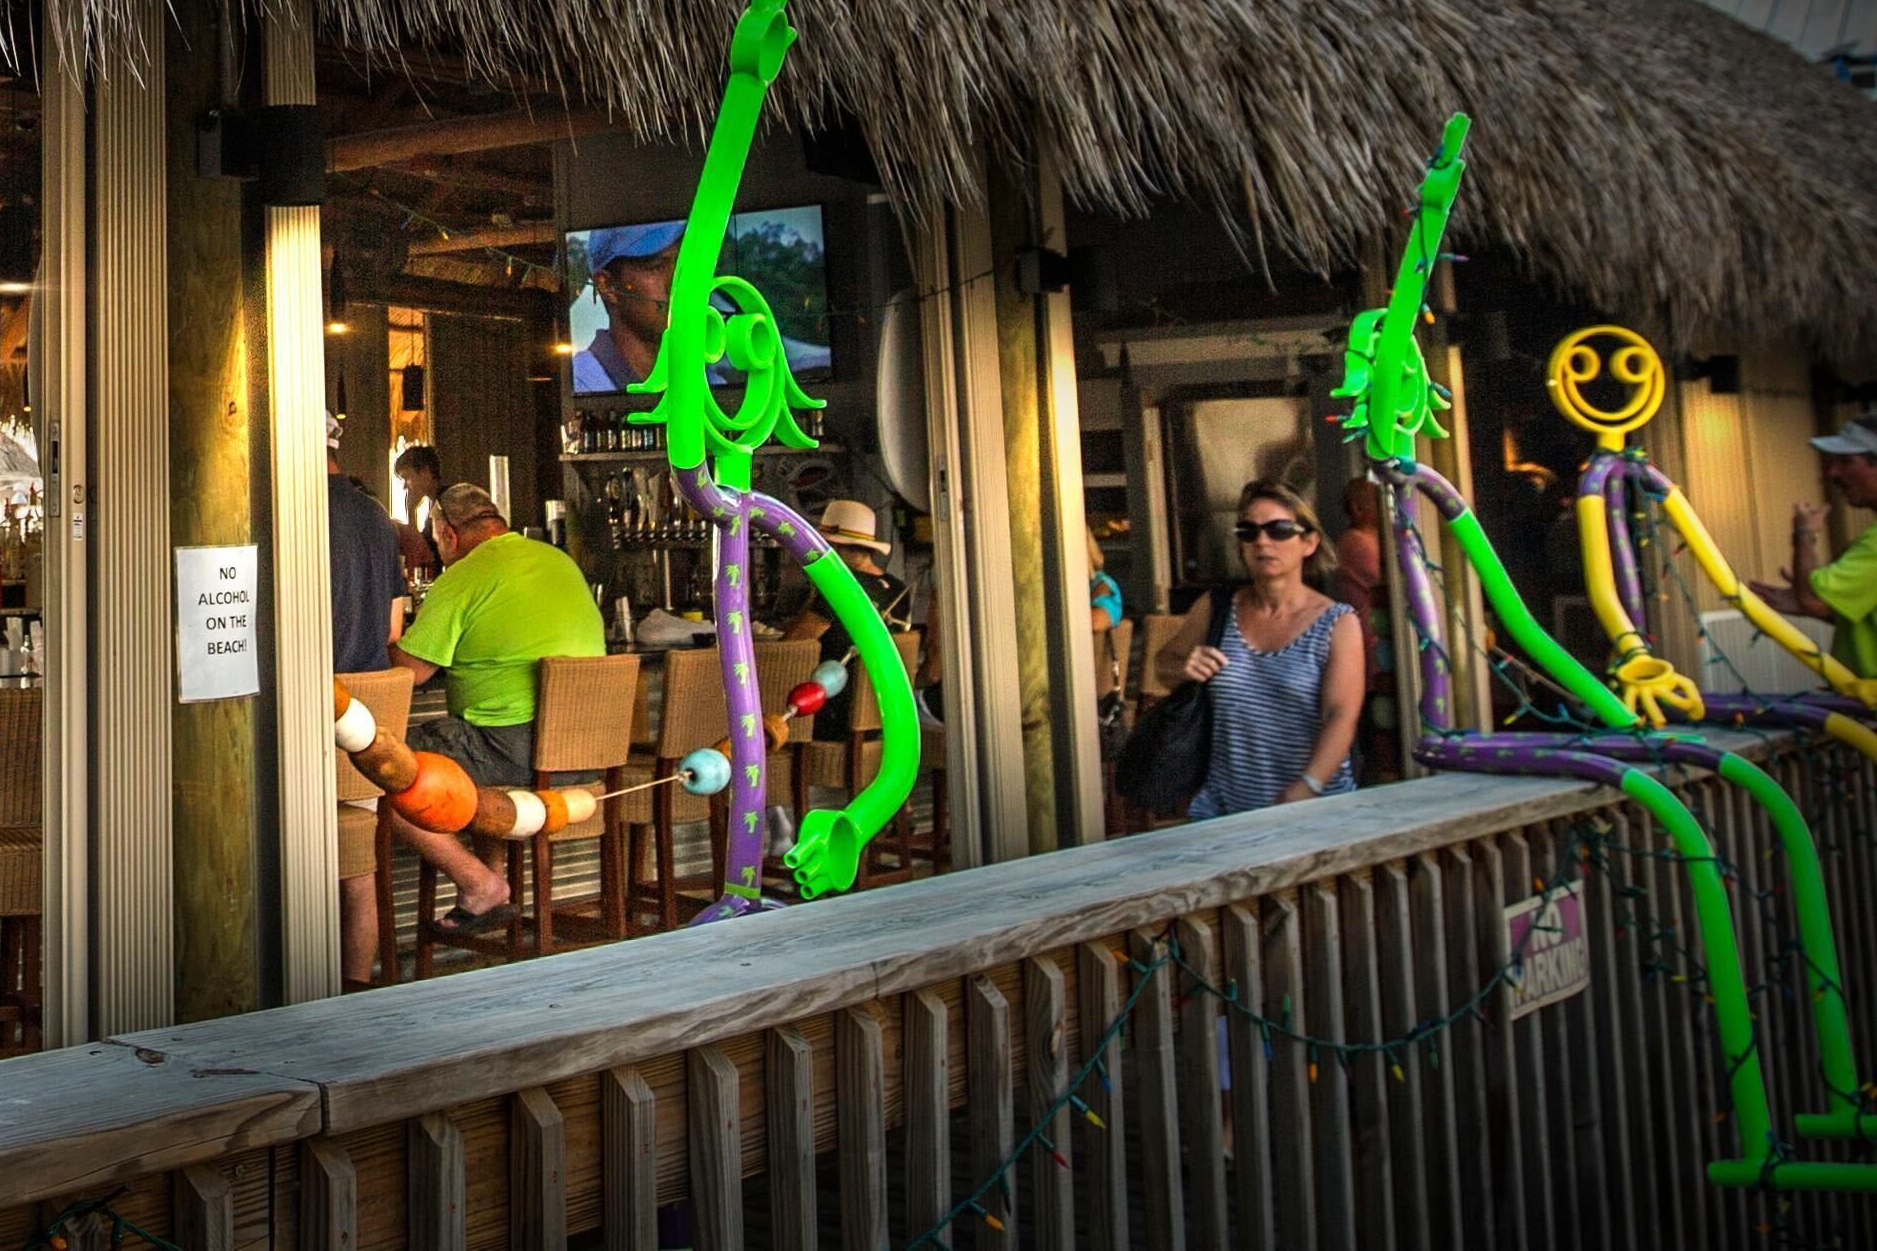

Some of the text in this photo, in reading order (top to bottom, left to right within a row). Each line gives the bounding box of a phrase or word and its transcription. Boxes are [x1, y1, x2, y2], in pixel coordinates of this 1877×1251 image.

[219, 567, 236, 580] NO
[198, 590, 249, 606] ALCOHOL
[206, 615, 247, 630] ON THE
[208, 639, 247, 655] BEACH!
[1531, 902, 1564, 951] NO
